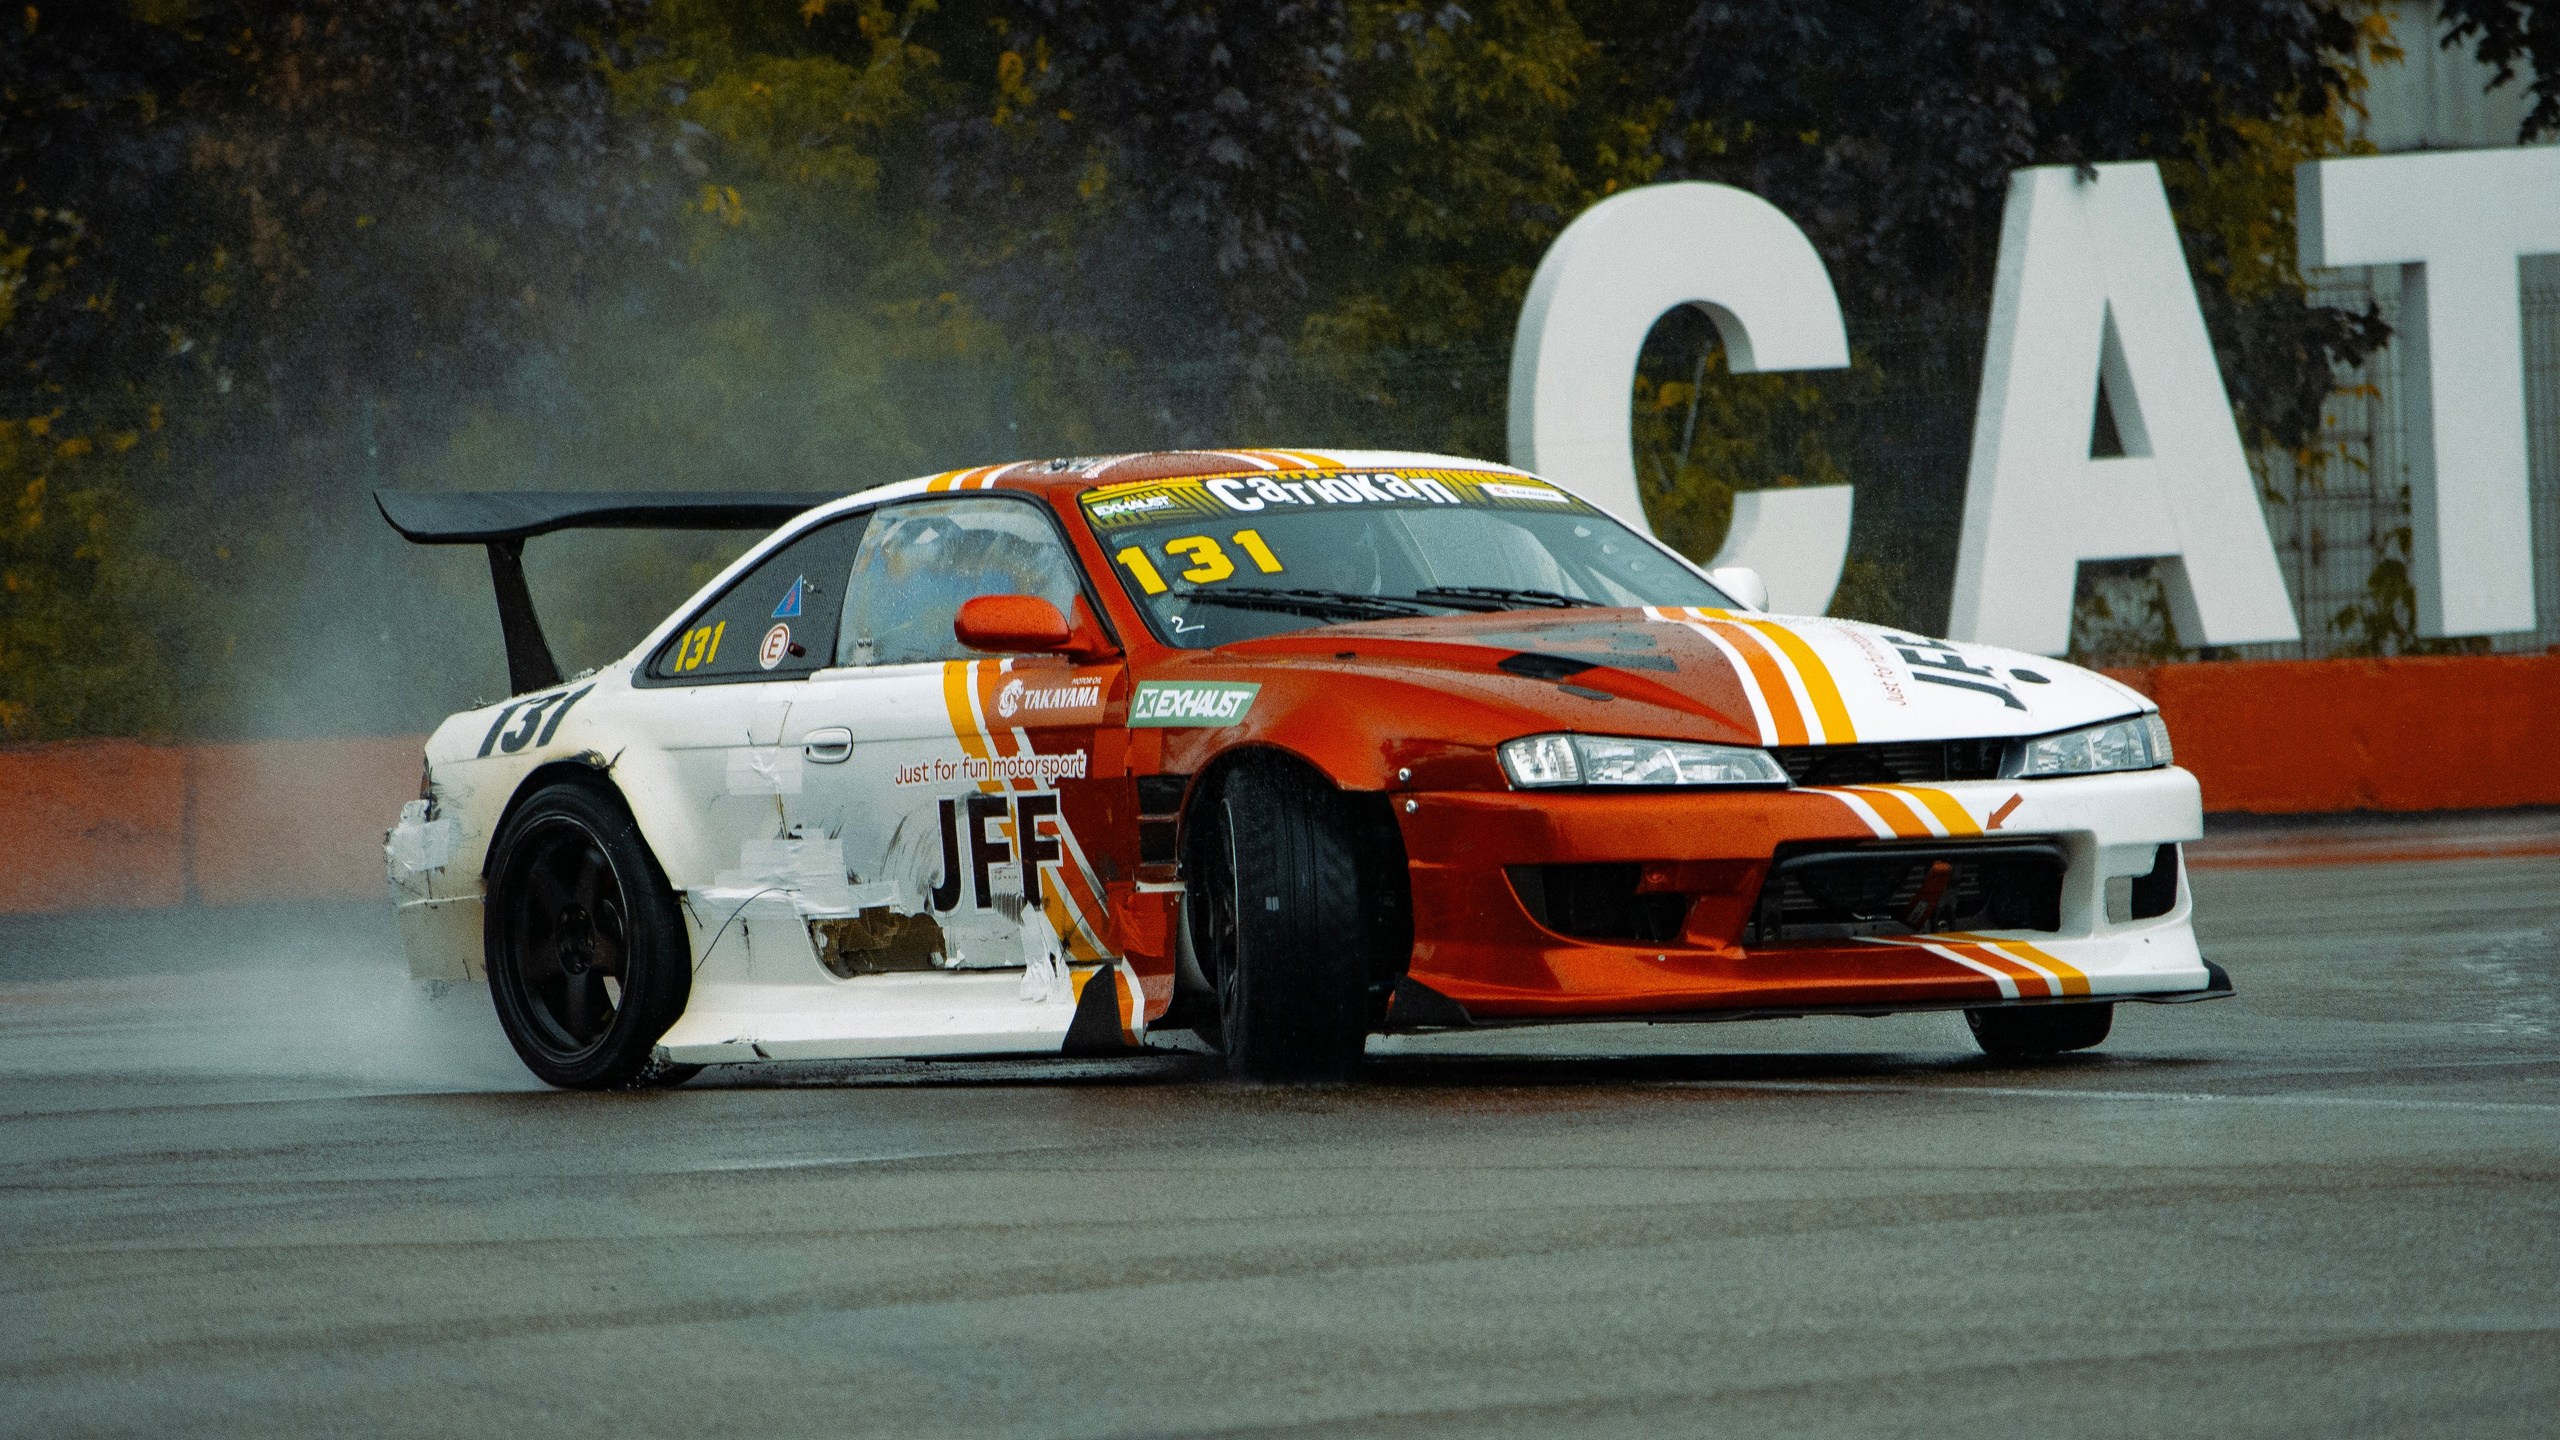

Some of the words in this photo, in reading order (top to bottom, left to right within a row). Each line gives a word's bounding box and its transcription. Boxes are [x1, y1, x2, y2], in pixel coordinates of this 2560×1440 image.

[1092, 496, 1169, 516] EXHAUST
[1116, 529, 1283, 595] 131
[674, 621, 726, 672] 131
[767, 633, 783, 659] E
[1024, 686, 1099, 709] TAKAYAMA
[477, 682, 598, 758] 131
[895, 762, 929, 785] Just
[934, 758, 957, 780] for
[963, 756, 988, 778] fun
[993, 753, 1085, 780] motorsport
[932, 794, 1060, 912] JFF
